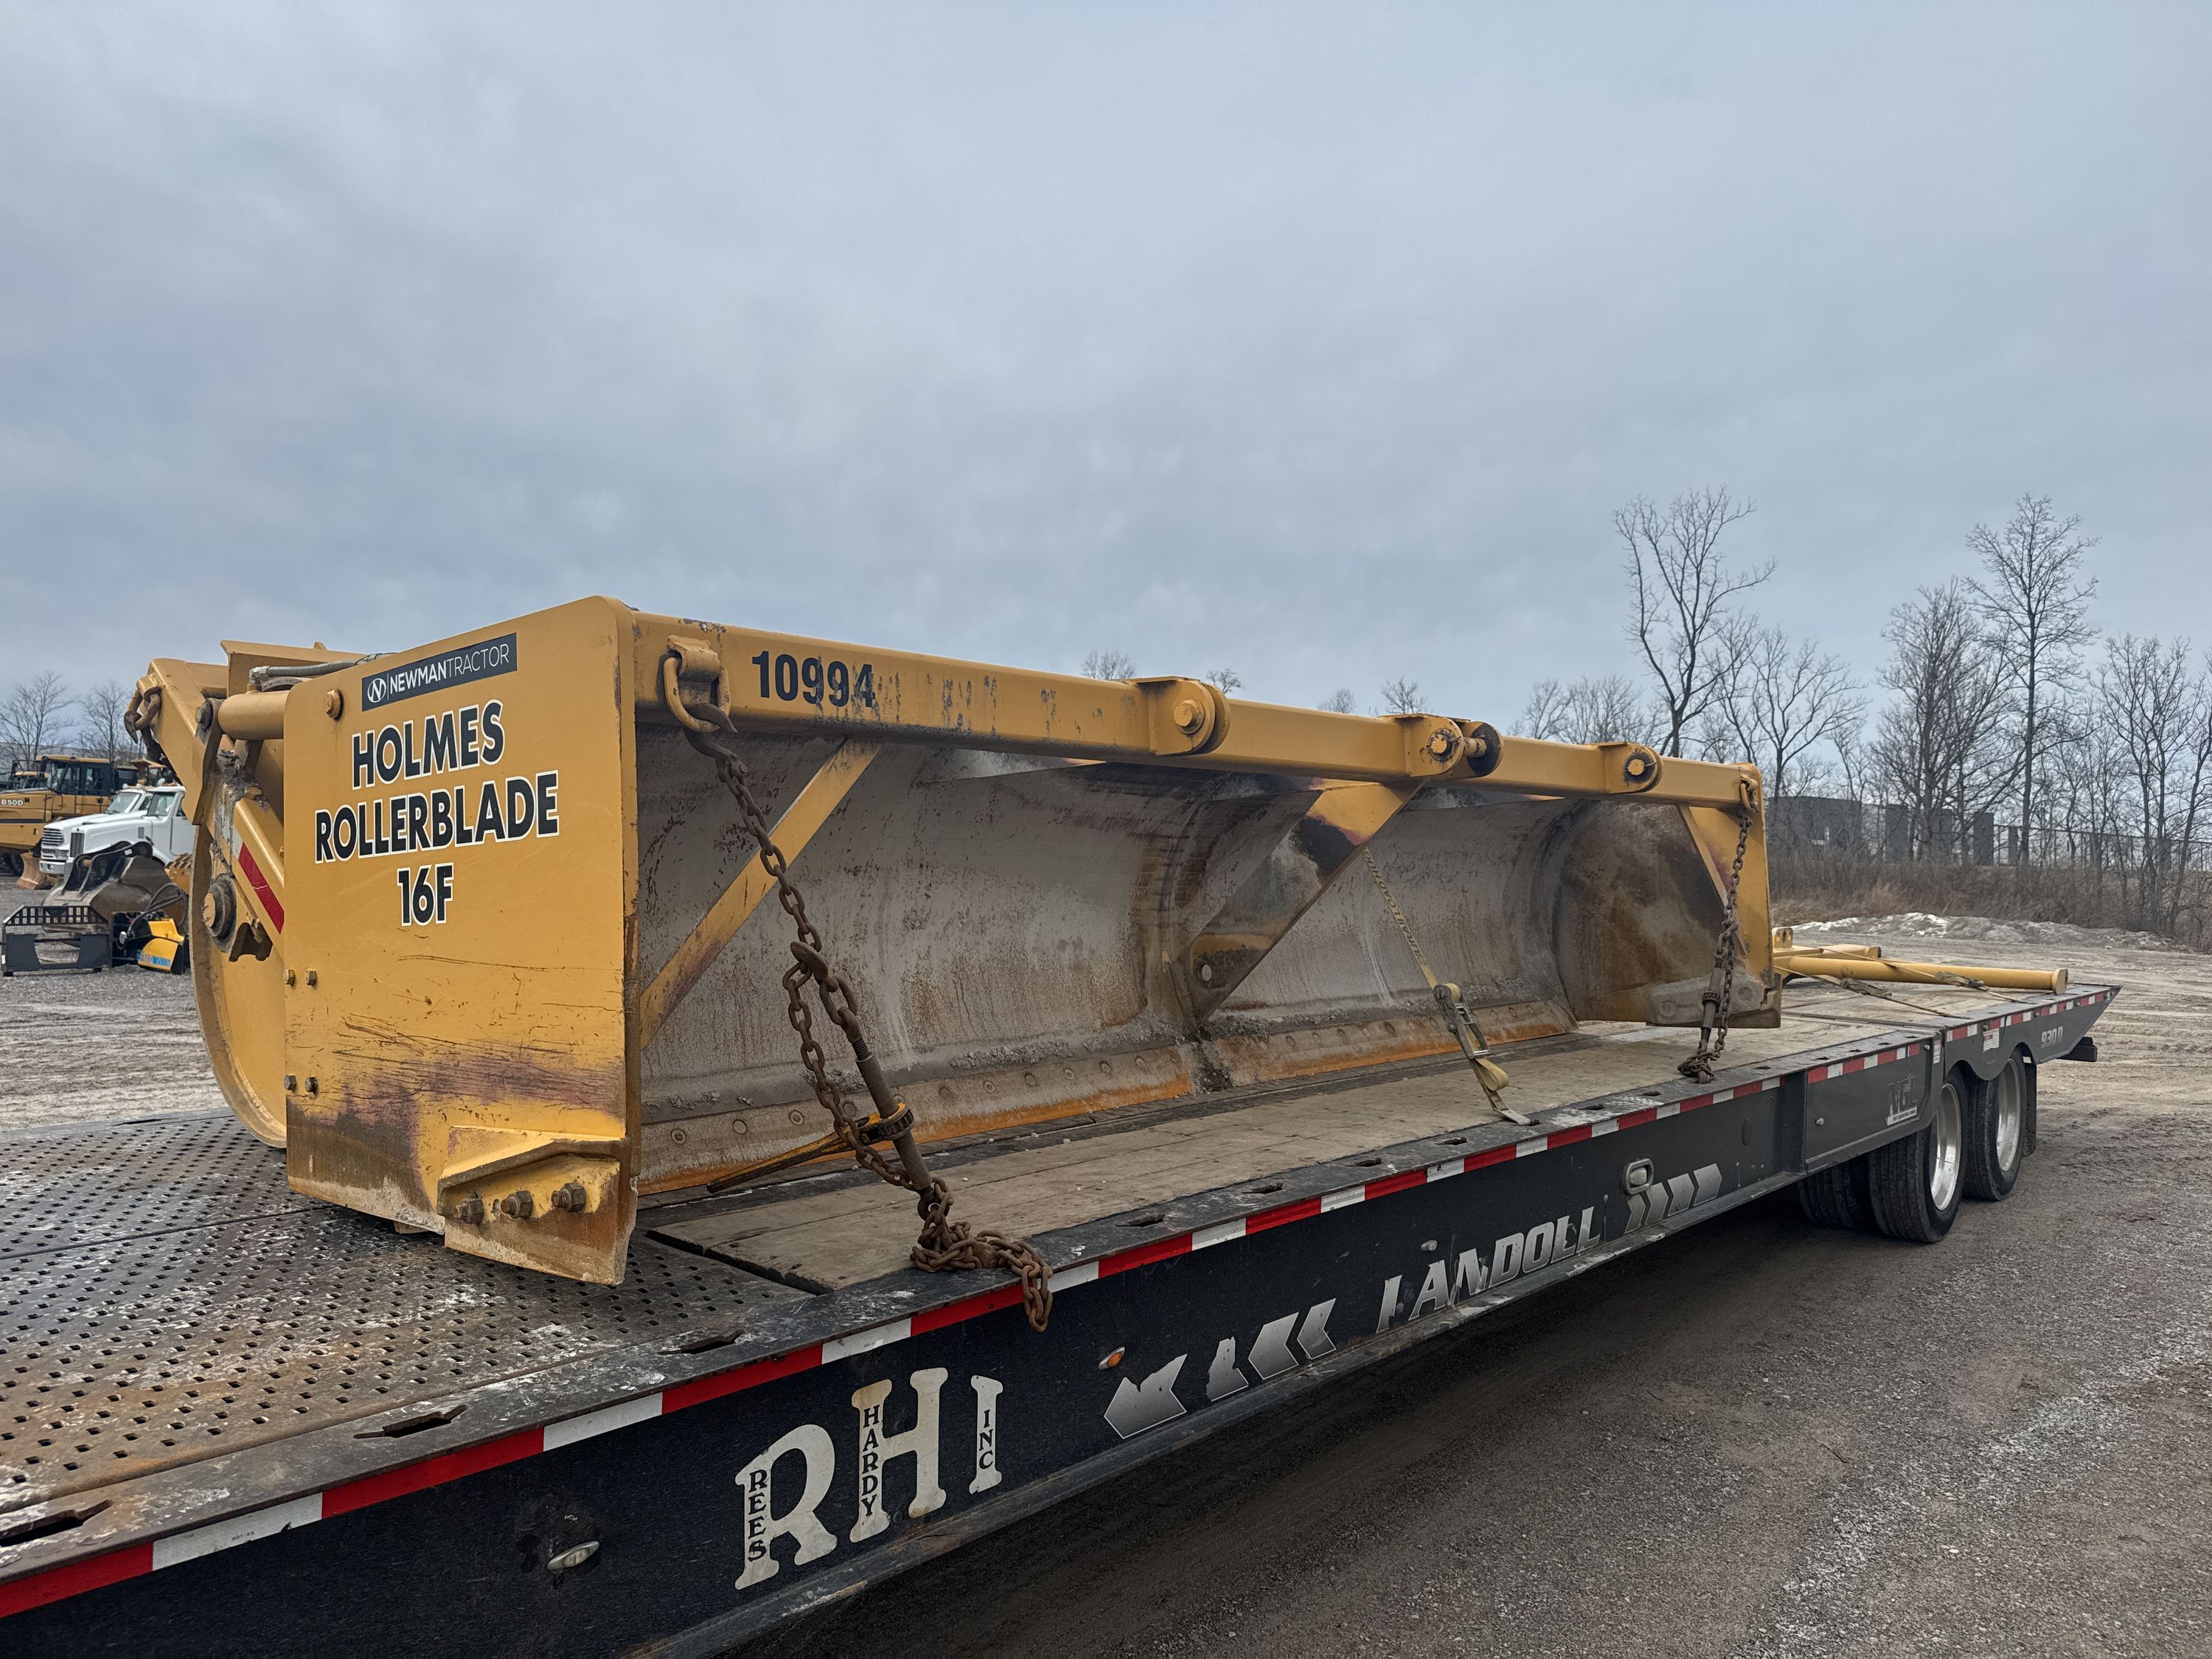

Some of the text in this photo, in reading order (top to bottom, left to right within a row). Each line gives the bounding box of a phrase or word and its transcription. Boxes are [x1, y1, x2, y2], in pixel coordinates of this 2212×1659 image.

[752, 650, 875, 708] 10994
[352, 699, 505, 790] HOLMES
[315, 770, 560, 863] ROLLERBLADE
[397, 862, 453, 926] 16F
[861, 1406, 880, 1517] HARDY
[978, 1409, 994, 1470] INC
[748, 1469, 768, 1562] REES
